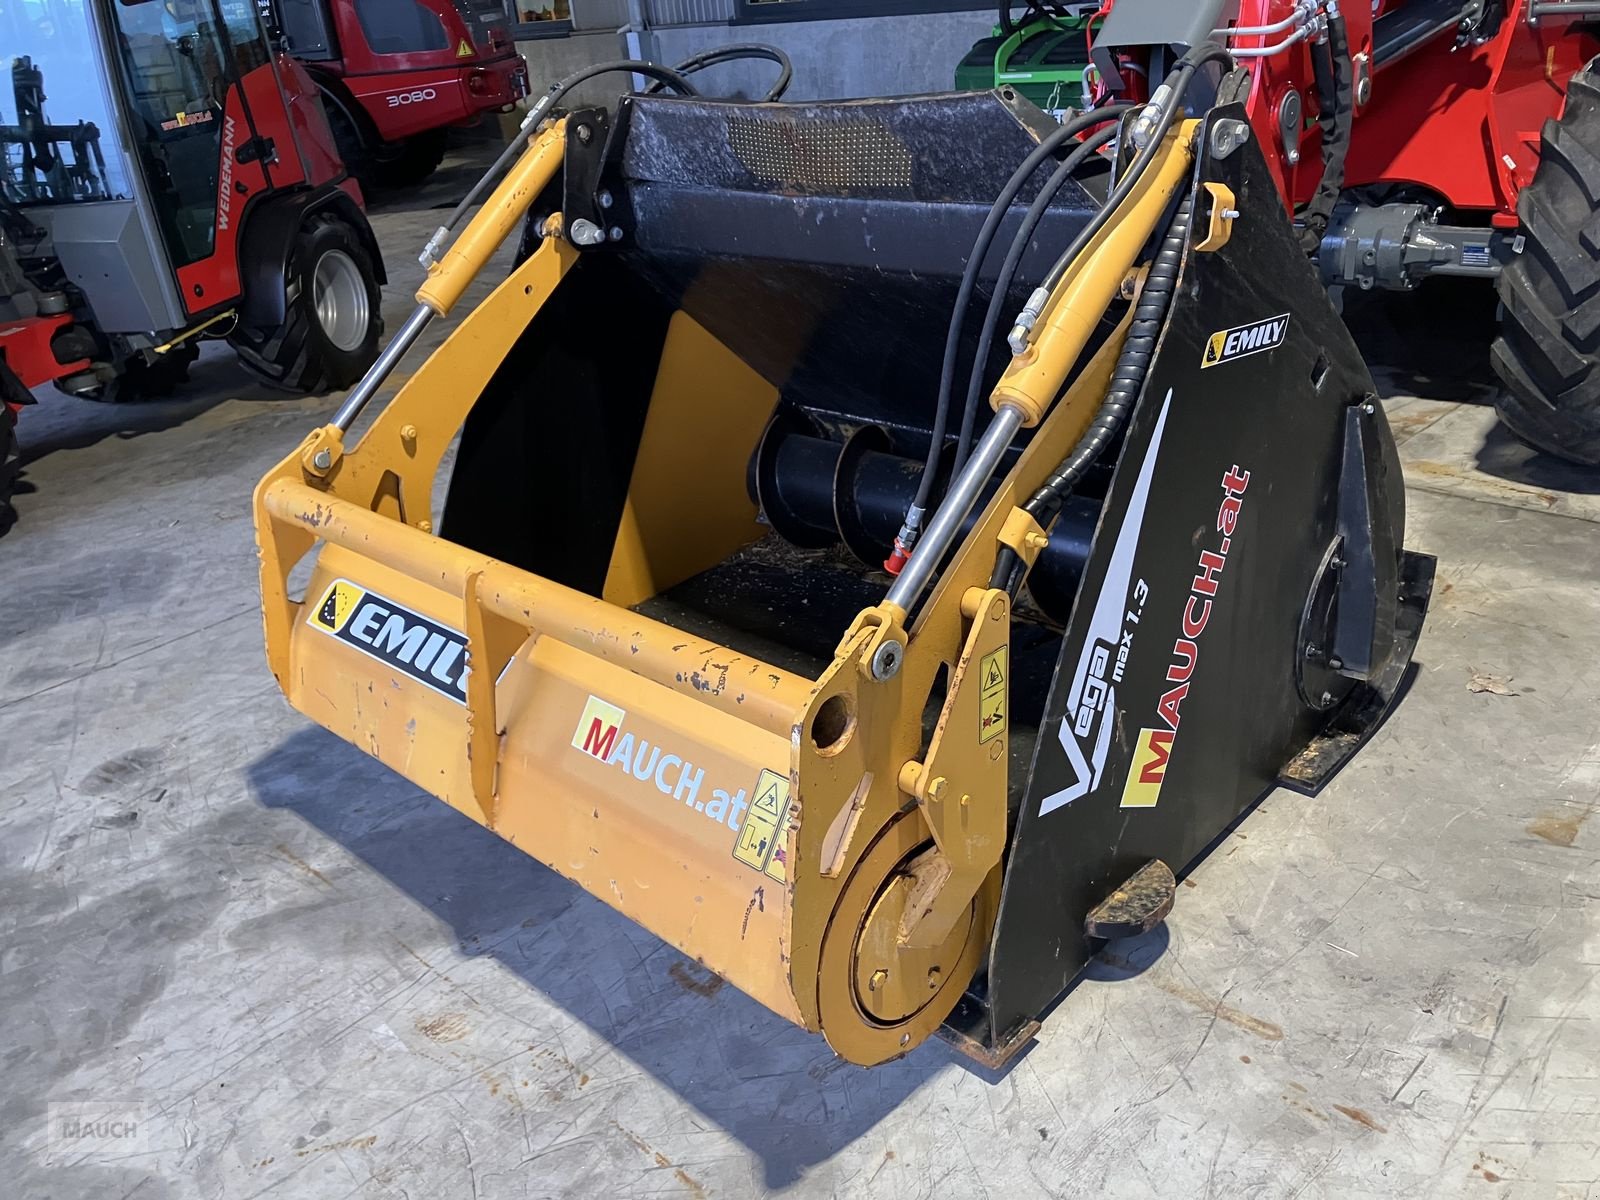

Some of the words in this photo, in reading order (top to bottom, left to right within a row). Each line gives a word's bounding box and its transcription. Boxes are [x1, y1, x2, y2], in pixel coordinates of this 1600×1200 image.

[386, 88, 436, 107] 3080
[219, 115, 236, 230] WEIDEMANN
[1223, 319, 1285, 356] EMILY
[1112, 629, 1135, 683] max
[1124, 578, 1149, 625] 1.3
[1138, 464, 1250, 784] MAUCH.at
[582, 716, 748, 832] MAUCH.at
